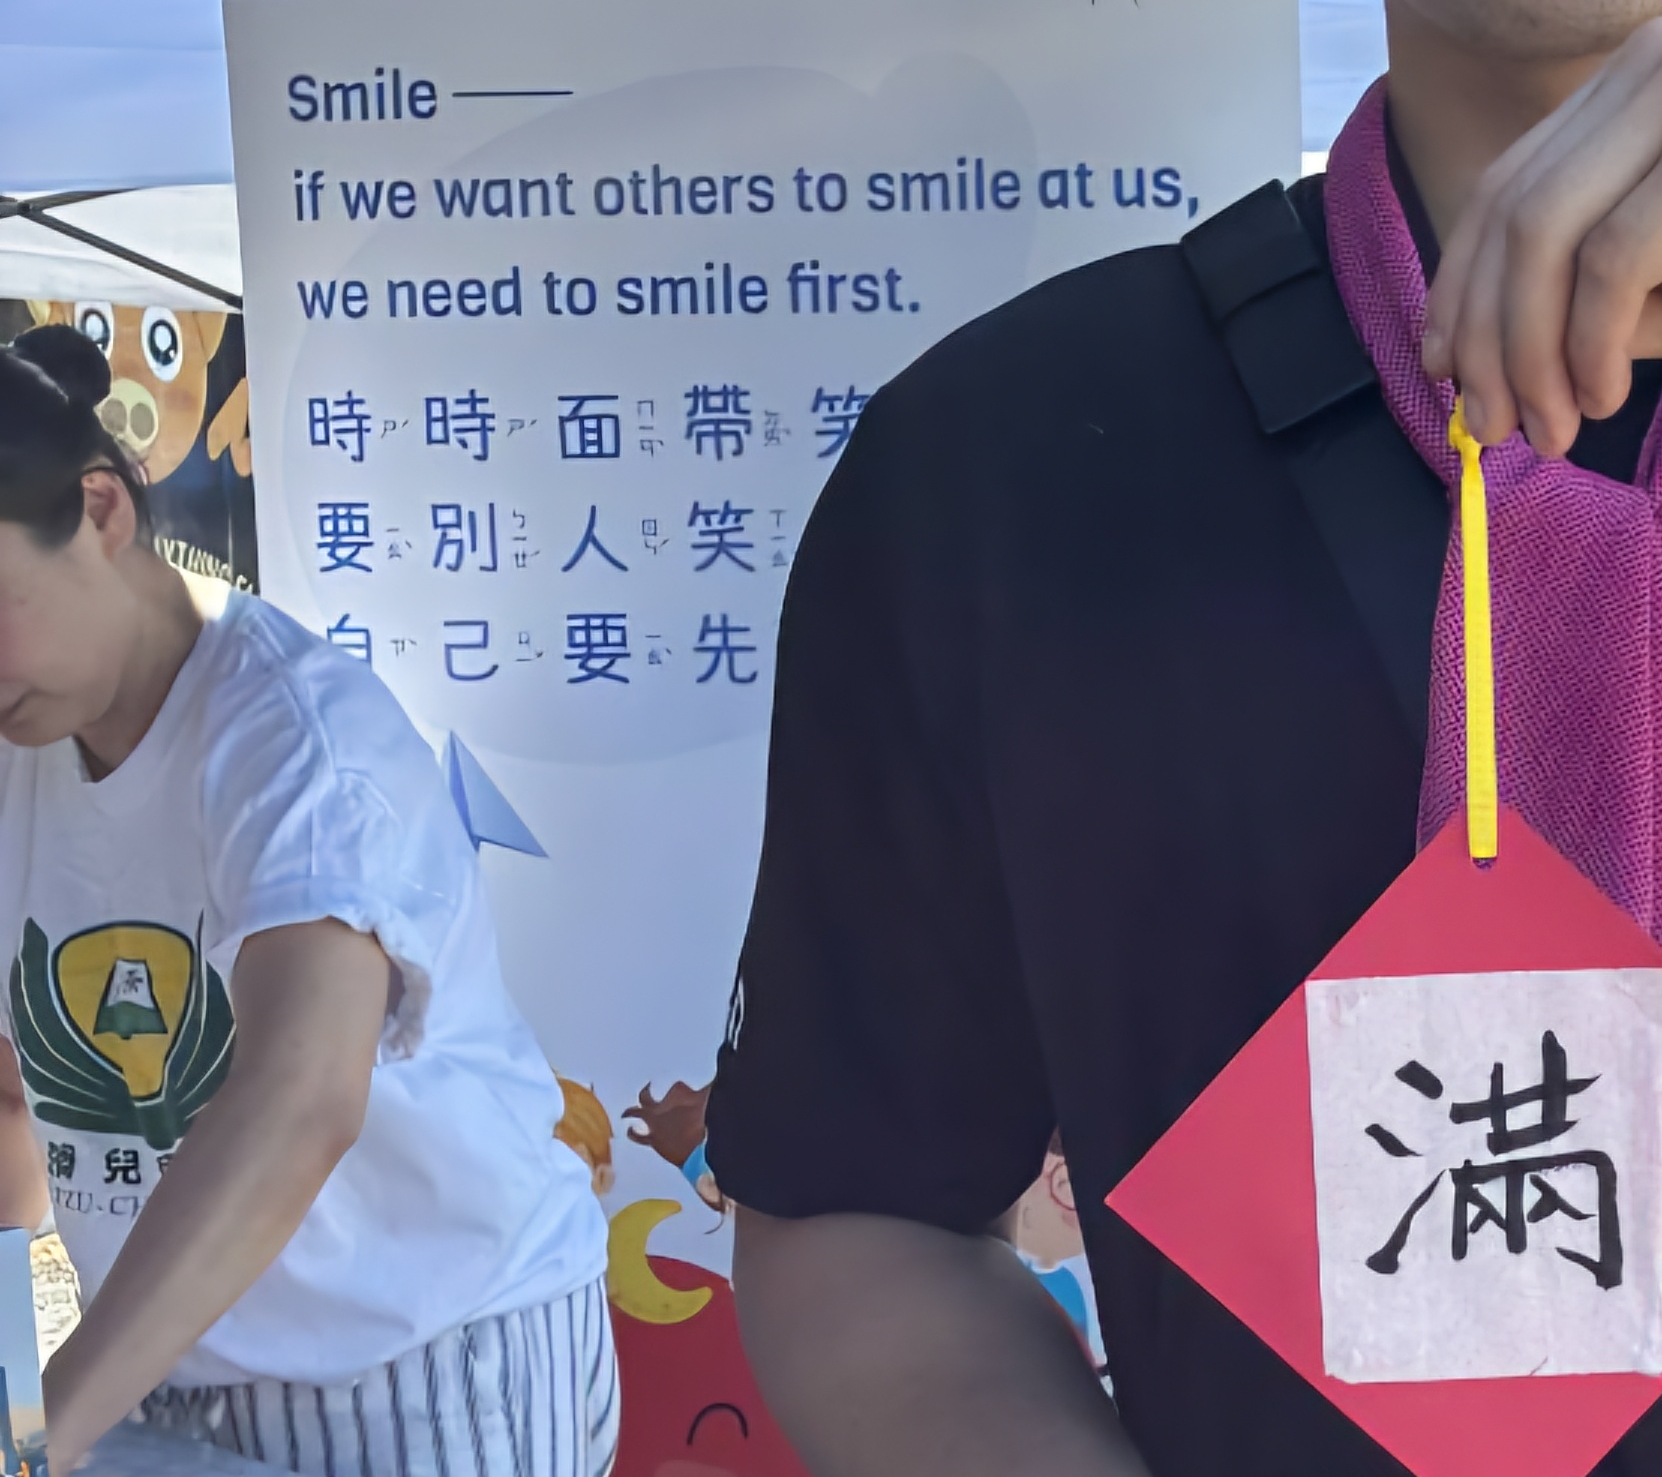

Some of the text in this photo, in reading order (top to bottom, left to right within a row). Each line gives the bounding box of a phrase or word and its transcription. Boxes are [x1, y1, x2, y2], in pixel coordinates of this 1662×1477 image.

[288, 66, 438, 122] Smile
[294, 156, 1199, 221] if we want others to smile at us,
[297, 259, 920, 320] we need to smile first.
[317, 499, 757, 573] 要別人笑
